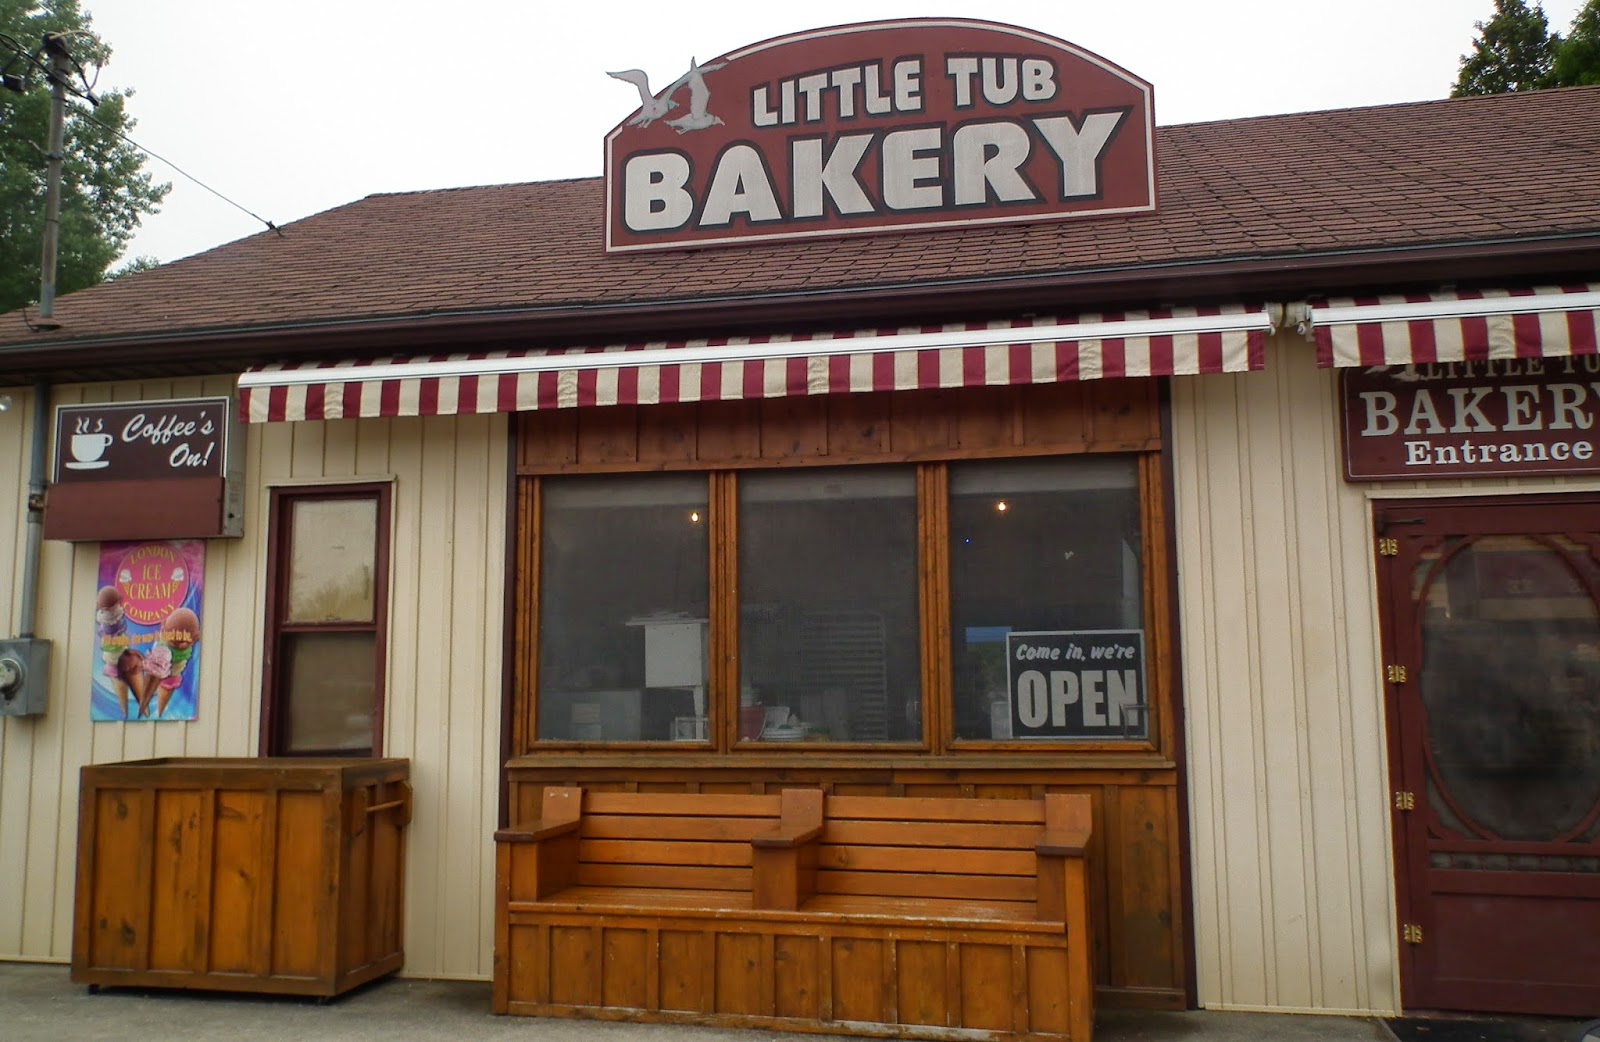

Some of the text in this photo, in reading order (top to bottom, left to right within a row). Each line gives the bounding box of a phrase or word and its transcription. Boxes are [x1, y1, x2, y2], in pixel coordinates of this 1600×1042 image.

[752, 58, 1057, 127] LITTLE TUB
[624, 112, 1124, 232] BAKERY
[121, 411, 215, 445] Coffee's
[168, 442, 216, 468] On!
[1404, 440, 1593, 466] Entrance
[130, 545, 176, 565] LONDON
[142, 564, 162, 581] ICE
[129, 582, 171, 600] CREAM
[123, 601, 175, 621] COMPANY
[1015, 643, 1136, 661] Come in, we're
[1017, 669, 1139, 728] OPEN
